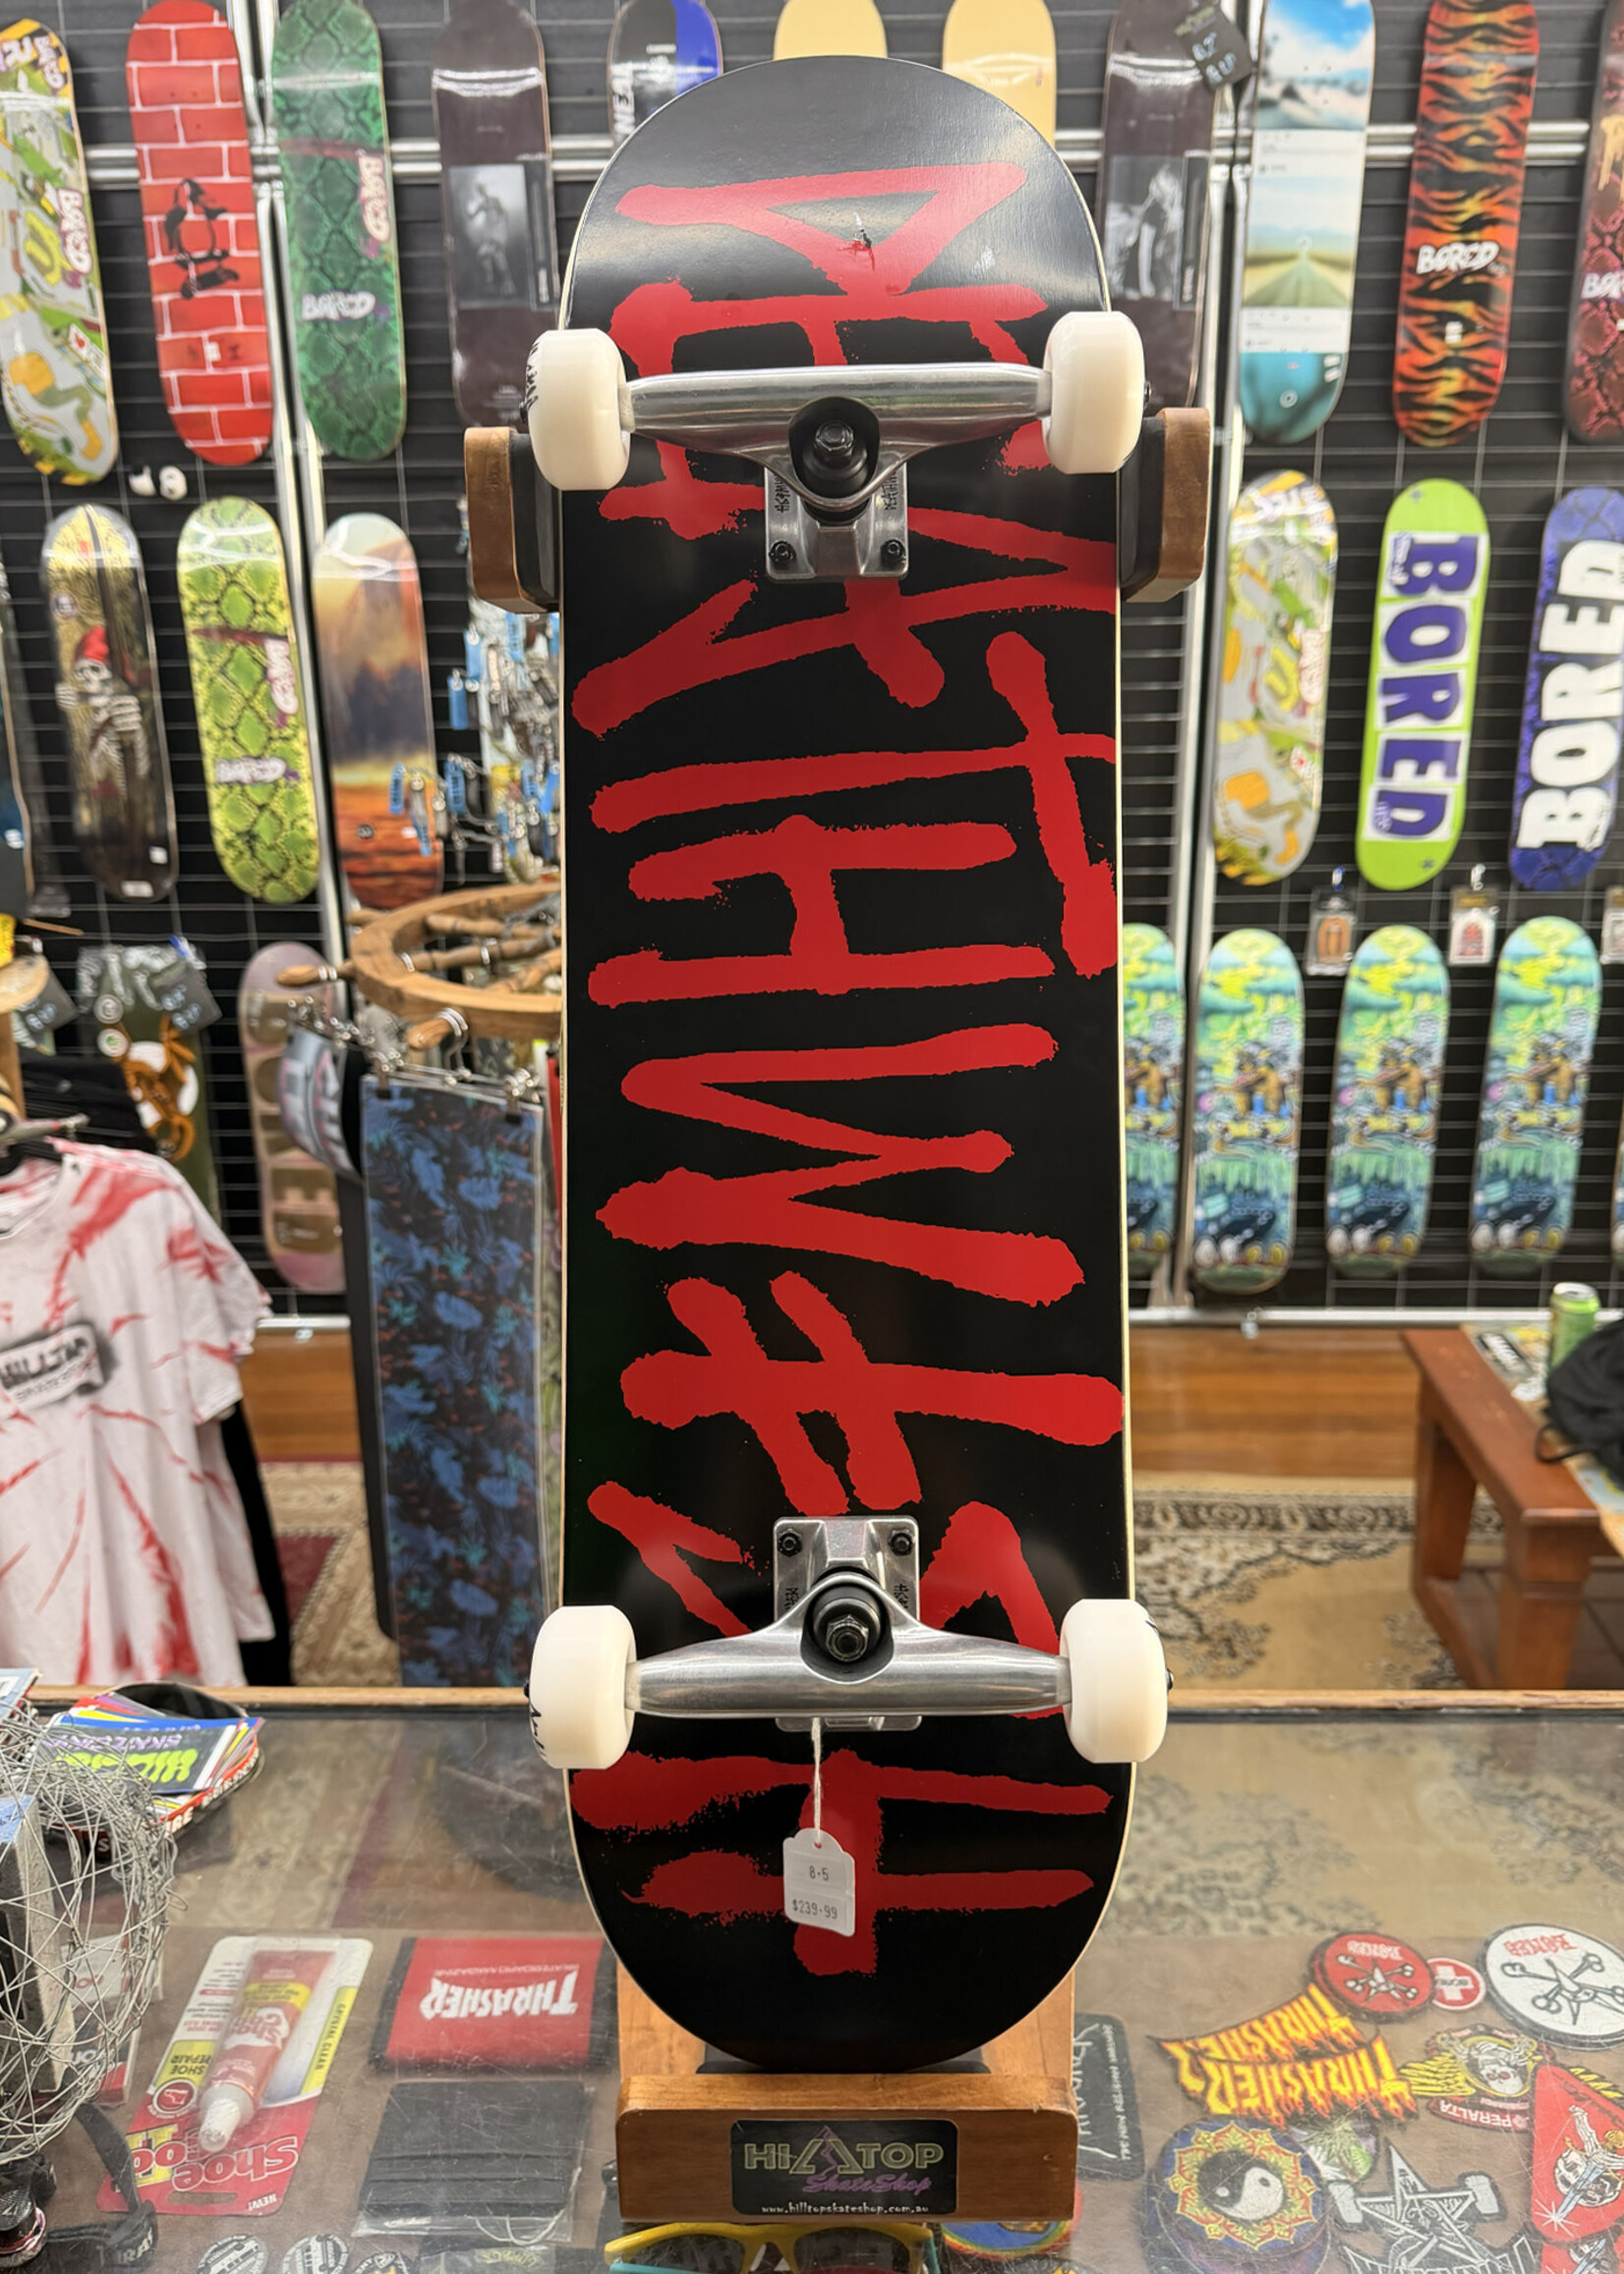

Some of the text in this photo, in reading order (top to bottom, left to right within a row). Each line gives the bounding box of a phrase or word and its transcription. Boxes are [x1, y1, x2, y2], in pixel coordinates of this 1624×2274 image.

[1379, 535, 1480, 838] BORED
[1518, 540, 1624, 850] BORED
[419, 1969, 579, 2020] THRASHER
[170, 2065, 205, 2075] SHOE
[1196, 2035, 1417, 2130] THRASHER
[1439, 2099, 1513, 2128] PERALTA
[172, 2134, 299, 2192] Shoe
[248, 2192, 278, 2211] NEW!
[761, 2201, 929, 2216] www.hilltopskateshop.com.au
